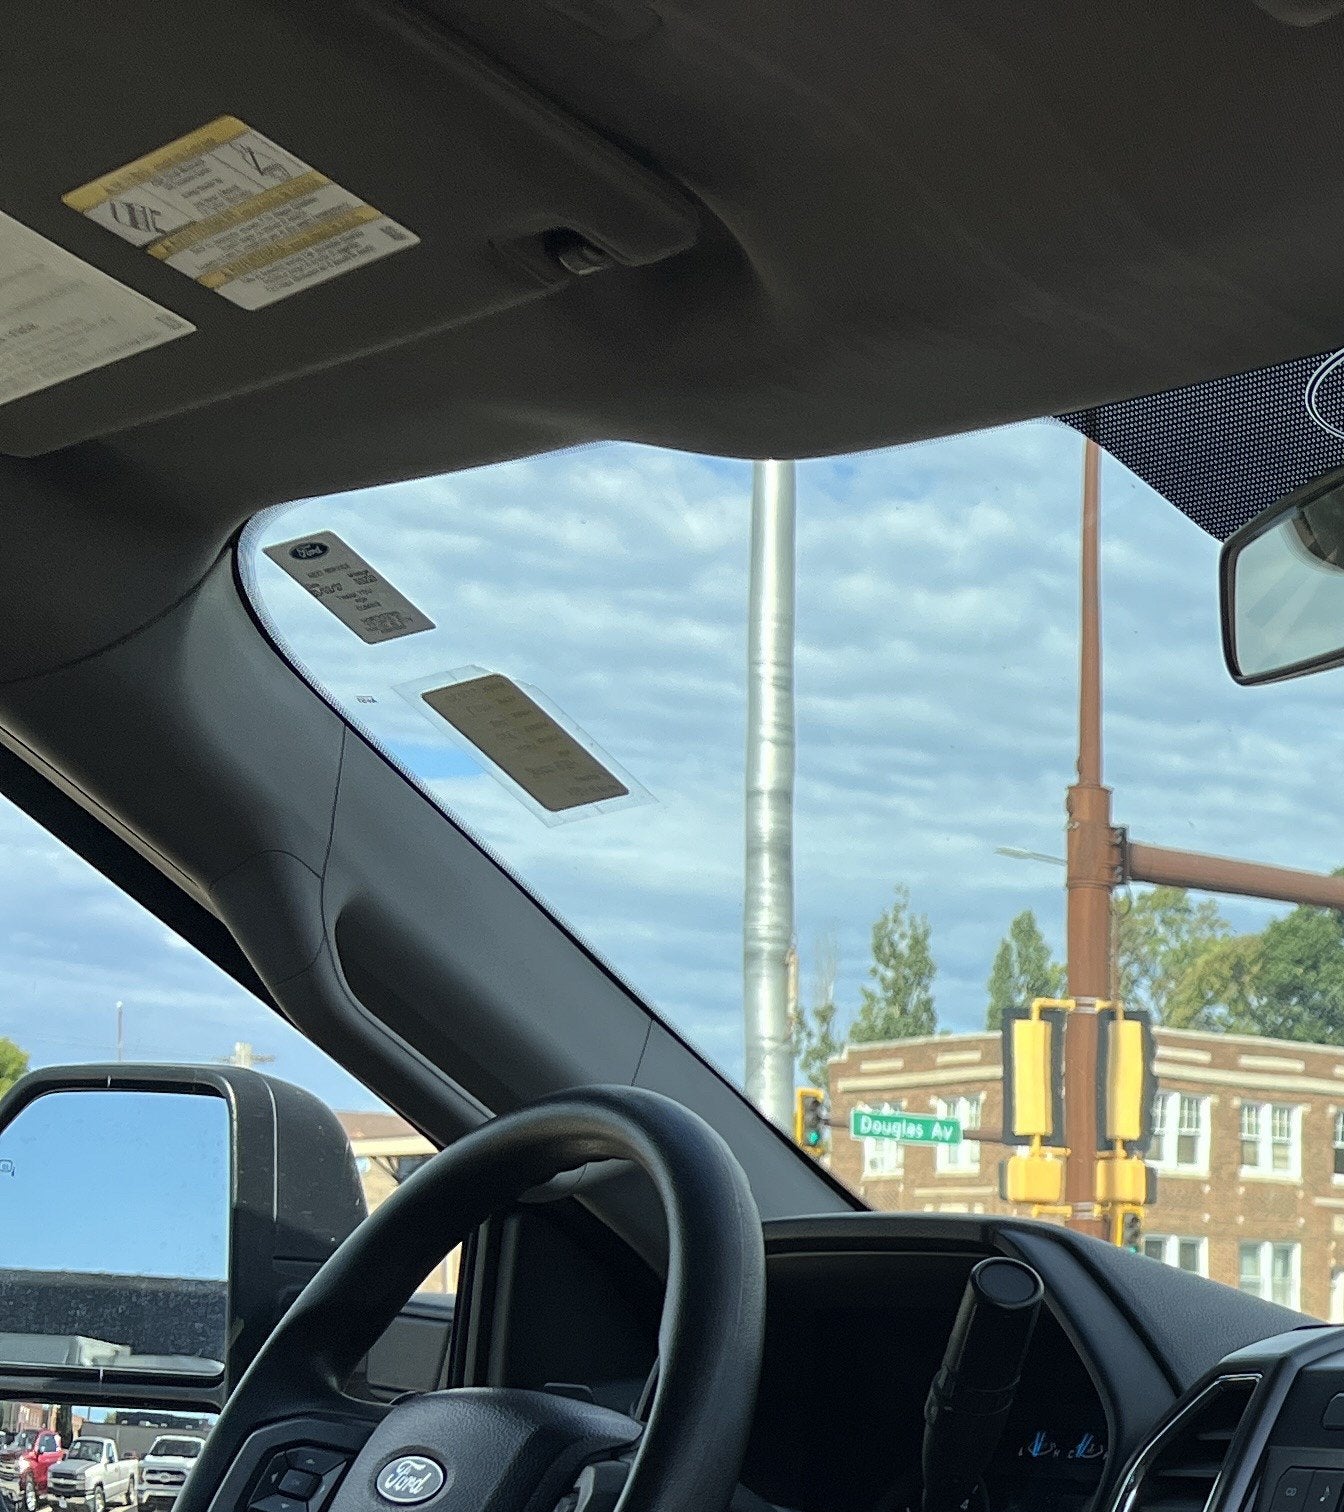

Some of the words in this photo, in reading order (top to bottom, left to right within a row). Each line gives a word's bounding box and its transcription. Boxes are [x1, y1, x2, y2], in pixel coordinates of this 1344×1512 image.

[861, 1114, 924, 1140] Douglas
[931, 1121, 954, 1141] Av
[384, 1460, 432, 1495] Ford
